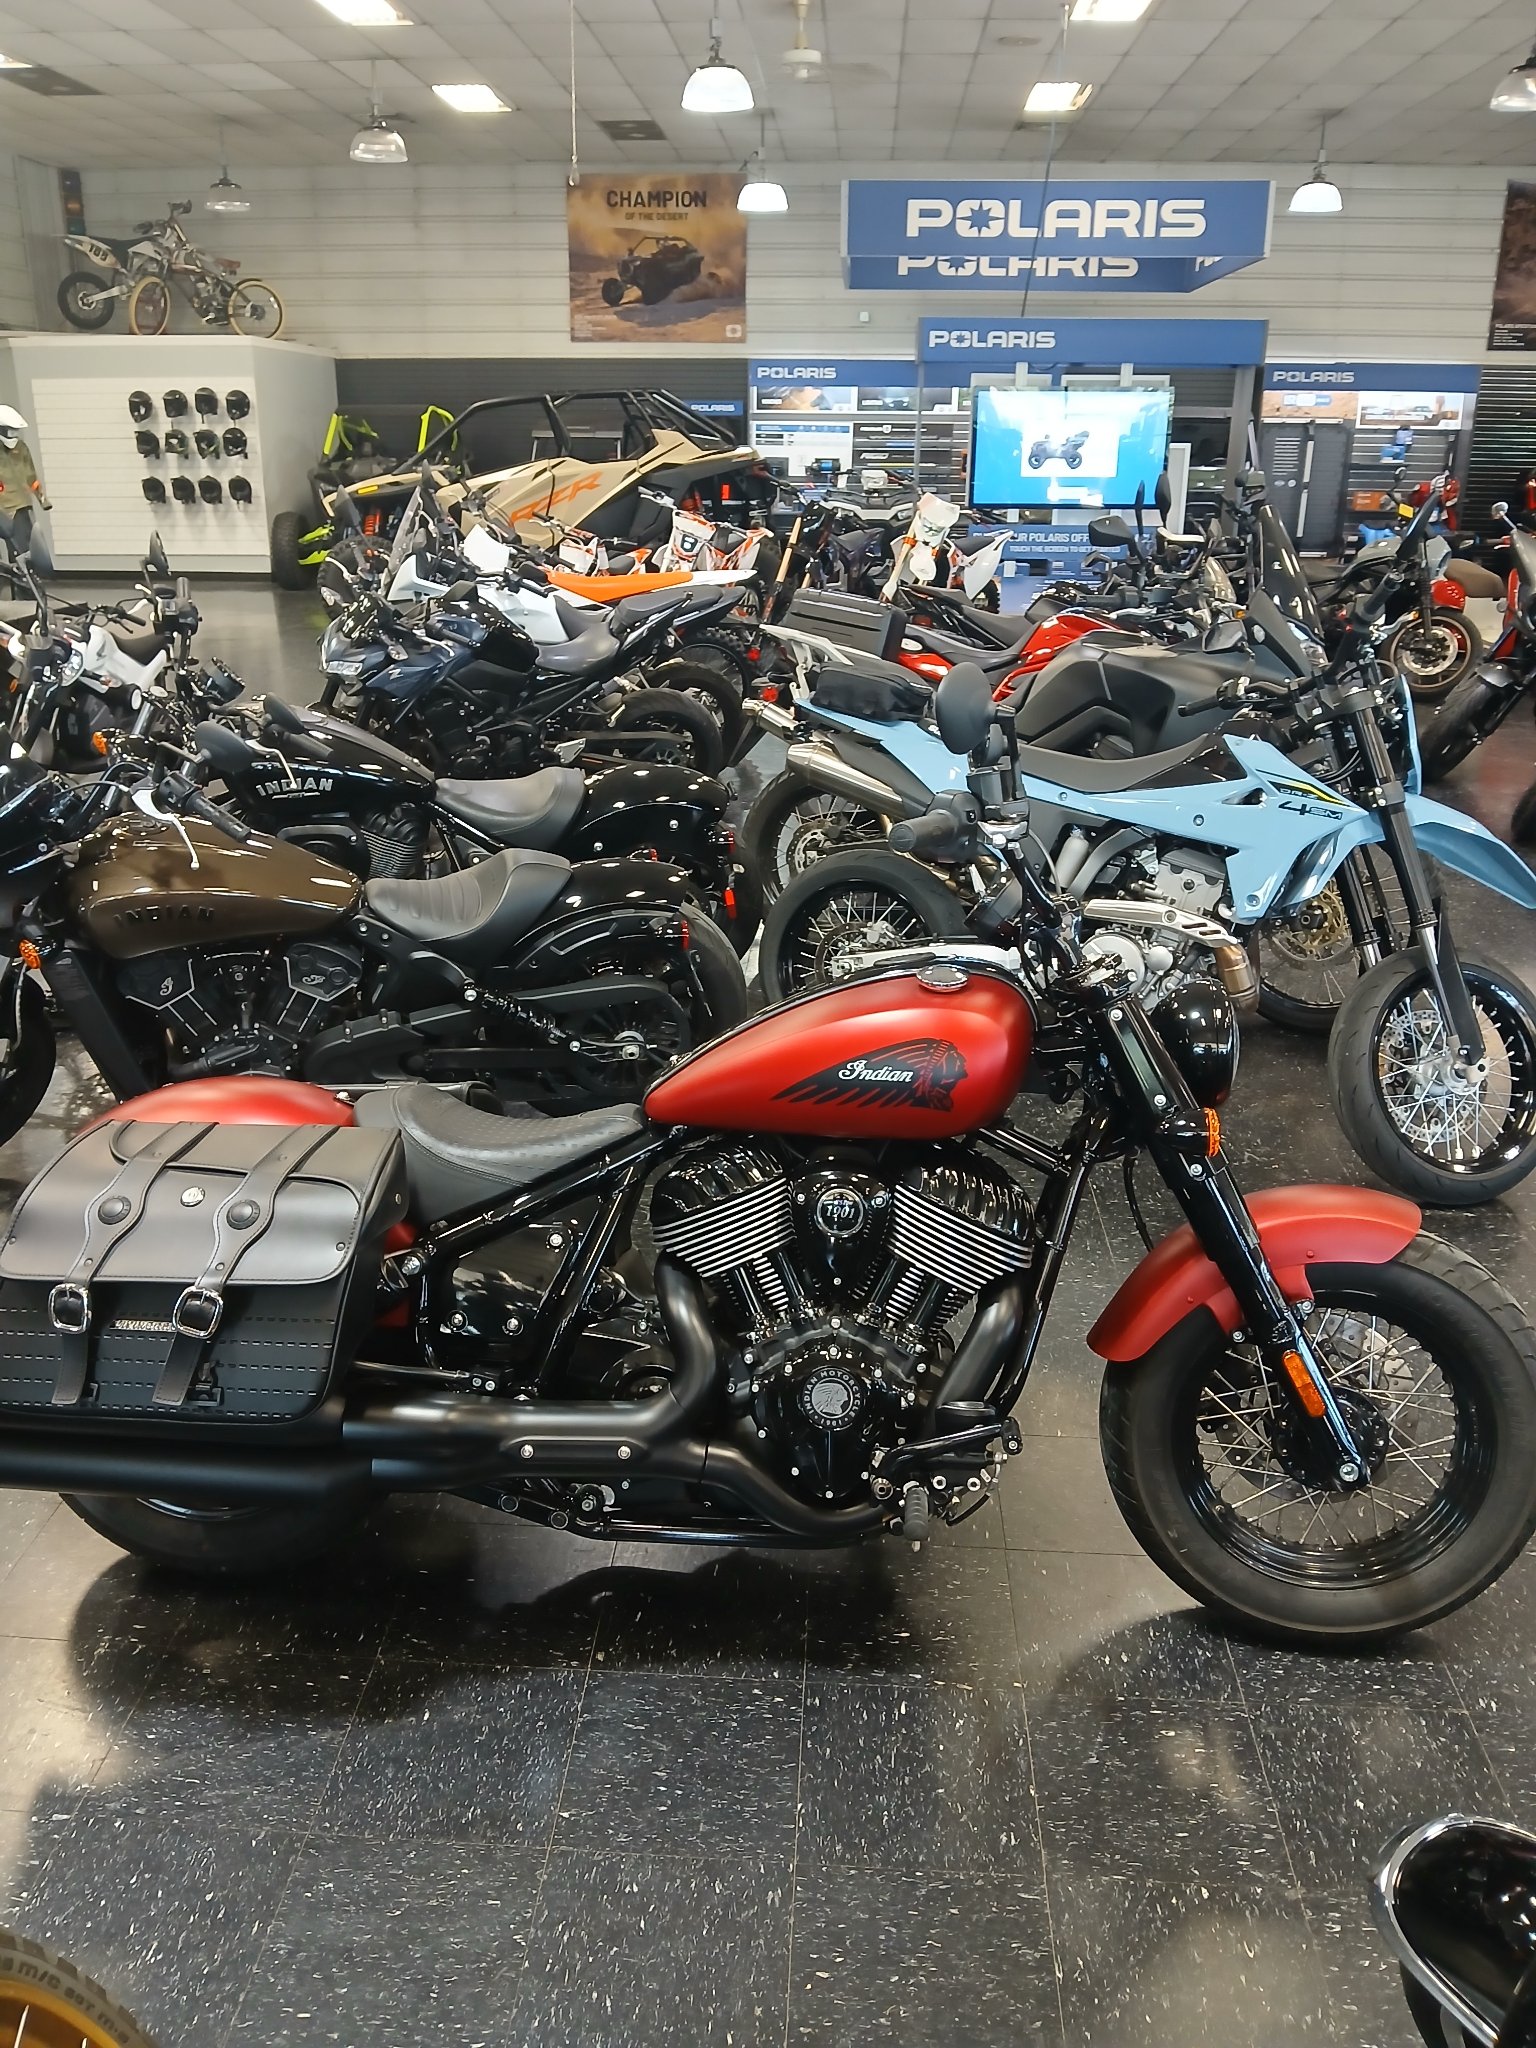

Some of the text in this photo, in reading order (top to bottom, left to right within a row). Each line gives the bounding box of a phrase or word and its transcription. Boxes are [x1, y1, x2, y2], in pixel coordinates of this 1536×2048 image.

[606, 190, 707, 208] CHAMPION
[625, 212, 689, 221] OF THE DESERT
[906, 199, 1207, 238] POLARIS
[928, 330, 1056, 349] POLARIS
[757, 367, 836, 379] POLARIS
[1272, 371, 1355, 383] POLARIS
[511, 471, 604, 528] RZR
[1029, 532, 1070, 543] POLARIS
[256, 777, 333, 796] INDIAN
[838, 1059, 914, 1082] Indian
[826, 1204, 856, 1219] 1901
[803, 1370, 861, 1418] INDIAN MOTORCYCLE
